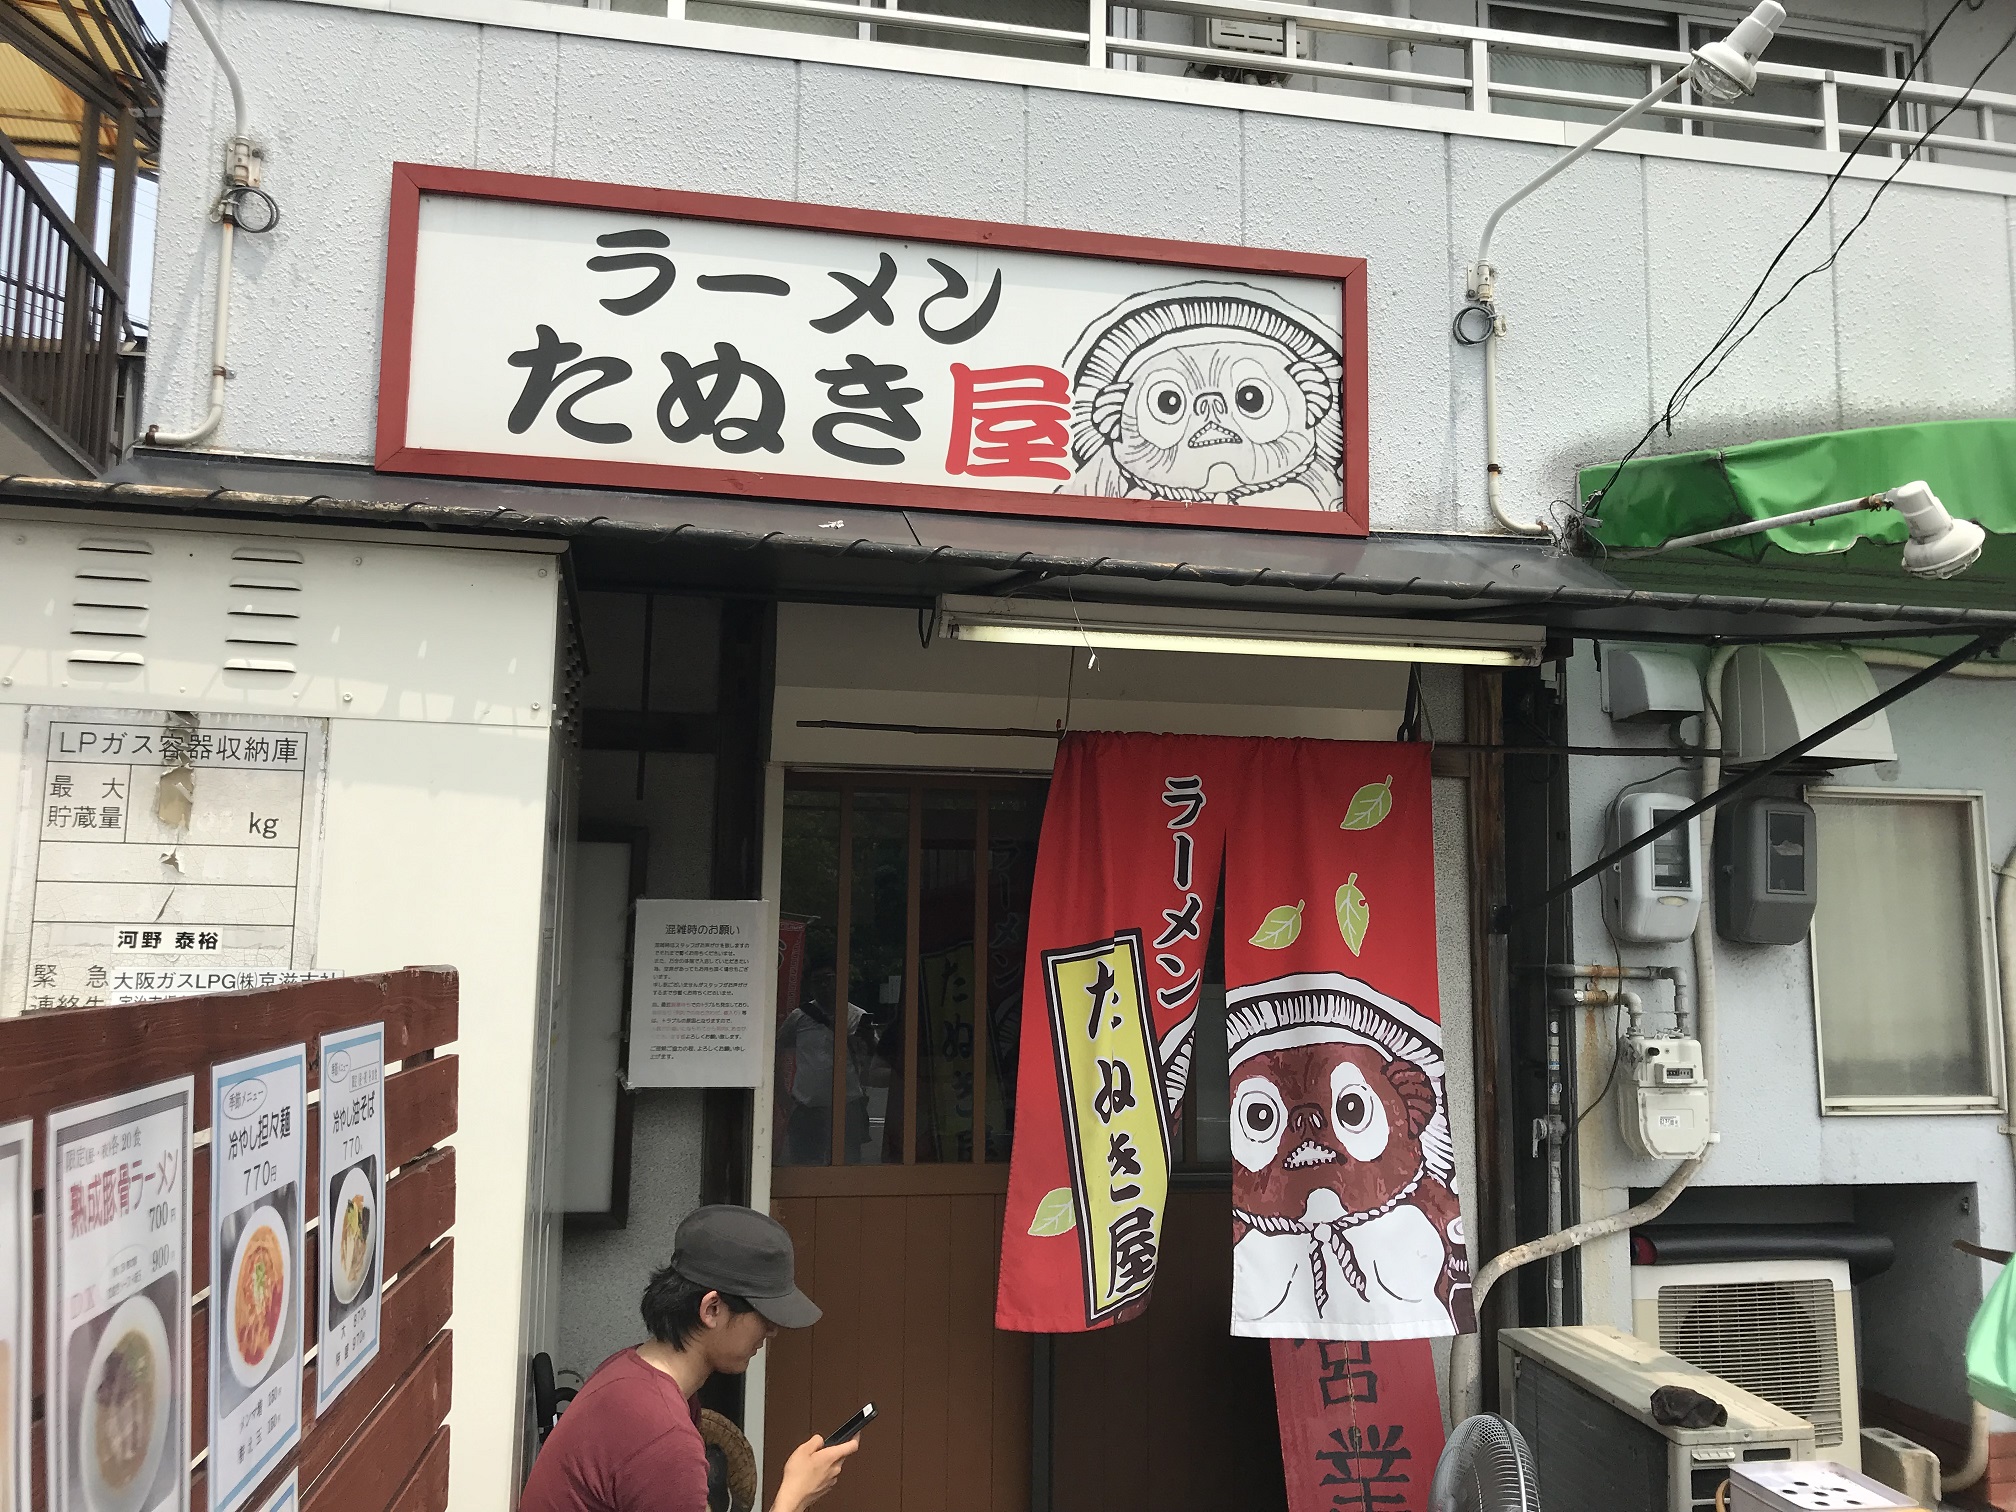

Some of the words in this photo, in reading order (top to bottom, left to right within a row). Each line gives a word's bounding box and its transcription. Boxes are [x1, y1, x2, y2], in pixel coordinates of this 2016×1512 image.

[586, 228, 1002, 346] ラーメン
[507, 323, 1074, 481] たぬき屋
[59, 731, 299, 764] LPガス容器収納庫
[46, 804, 123, 830] 貯蔵量
[248, 811, 280, 839] kg
[1153, 775, 1207, 1011] ラーメン
[117, 930, 162, 950] 河野
[174, 929, 219, 951] 泰裕
[665, 923, 740, 936] 混雑時のお願い
[1085, 959, 1158, 1300] たぬき屋
[69, 1148, 180, 1240] 熟成豚骨ラーメン
[243, 1160, 277, 1196] 770円
[149, 1200, 176, 1232] 700円
